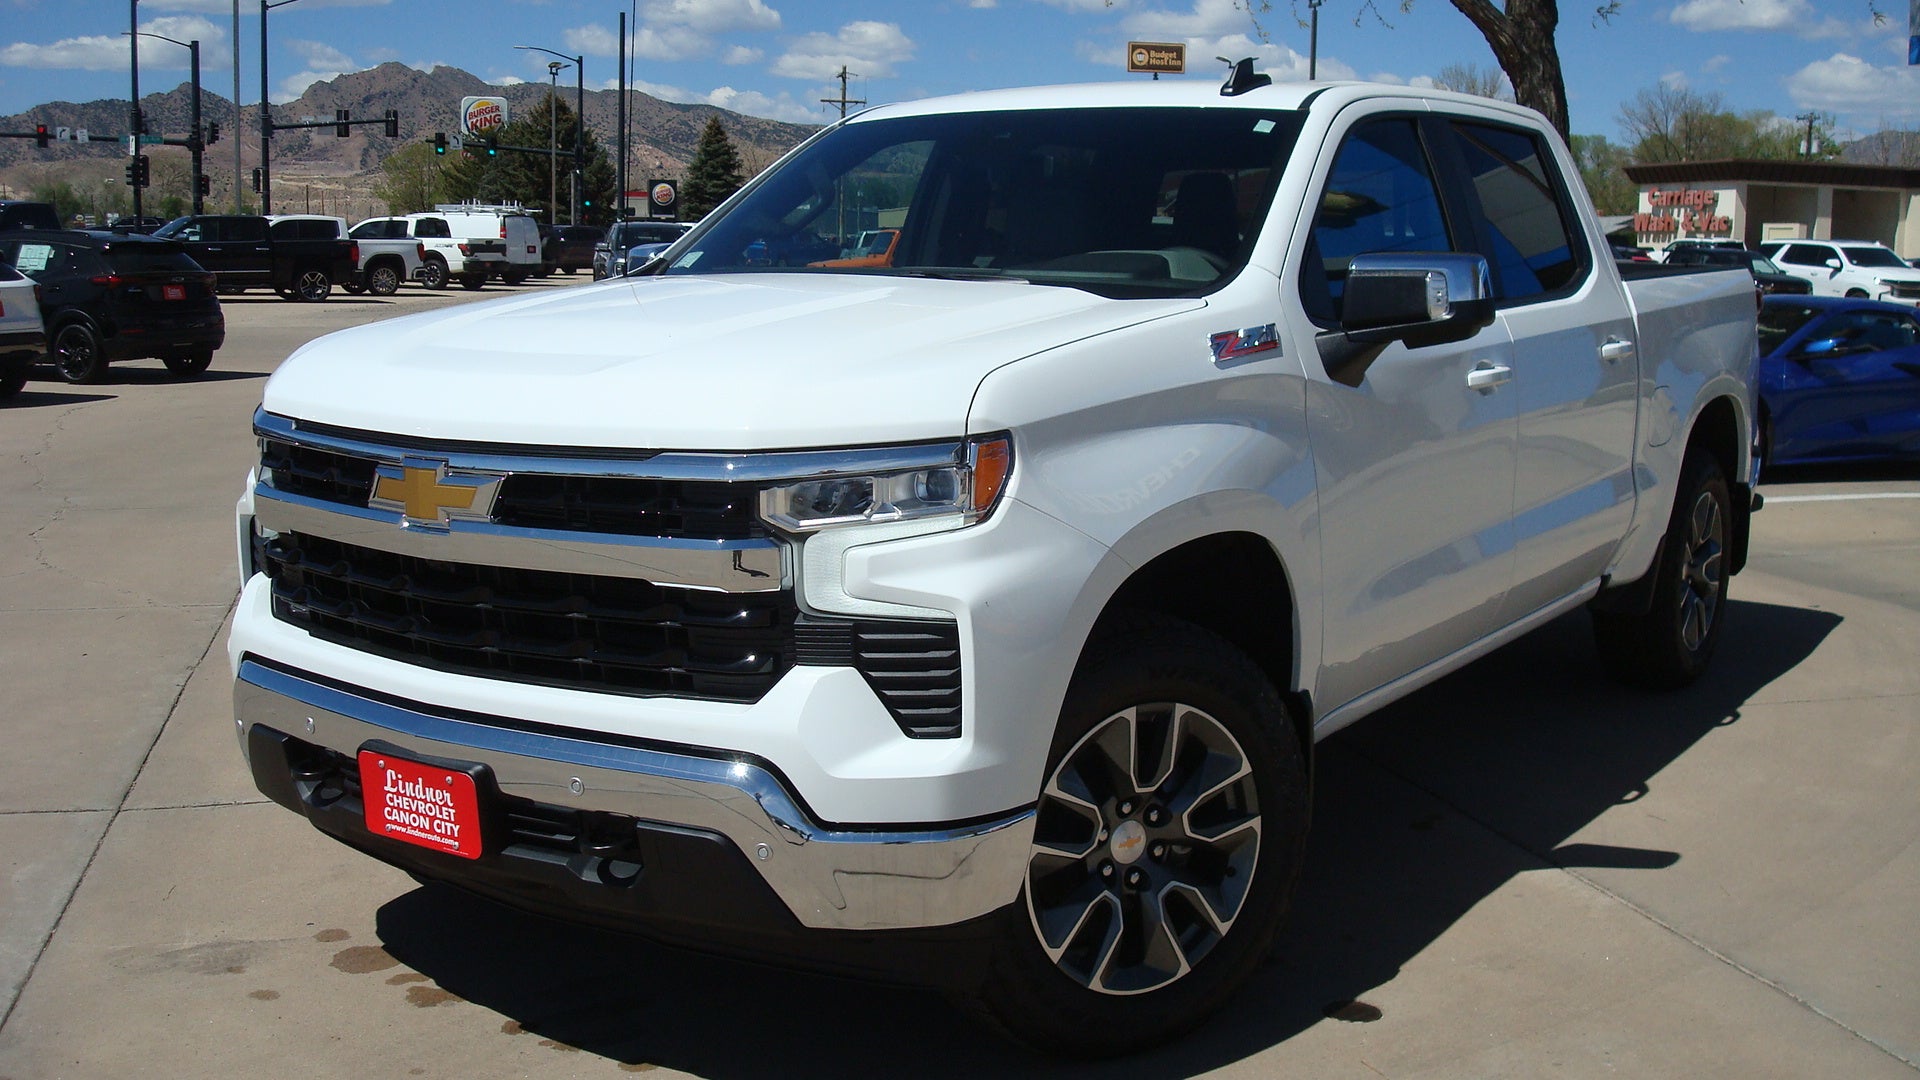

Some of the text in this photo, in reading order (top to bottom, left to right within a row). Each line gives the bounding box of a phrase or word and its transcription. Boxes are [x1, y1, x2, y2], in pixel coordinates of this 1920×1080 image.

[1150, 50, 1177, 59] Budget
[1150, 57, 1168, 66] Host
[468, 104, 501, 120] BURGER
[470, 113, 502, 132] KING
[1647, 186, 1714, 210] Carriage
[1634, 211, 1729, 232] Wash & Vac
[384, 769, 454, 806] Lindner
[386, 793, 456, 821] CHEVROLET
[384, 806, 460, 837] CANON CITY
[391, 824, 456, 846] www.lindnerauto.com
